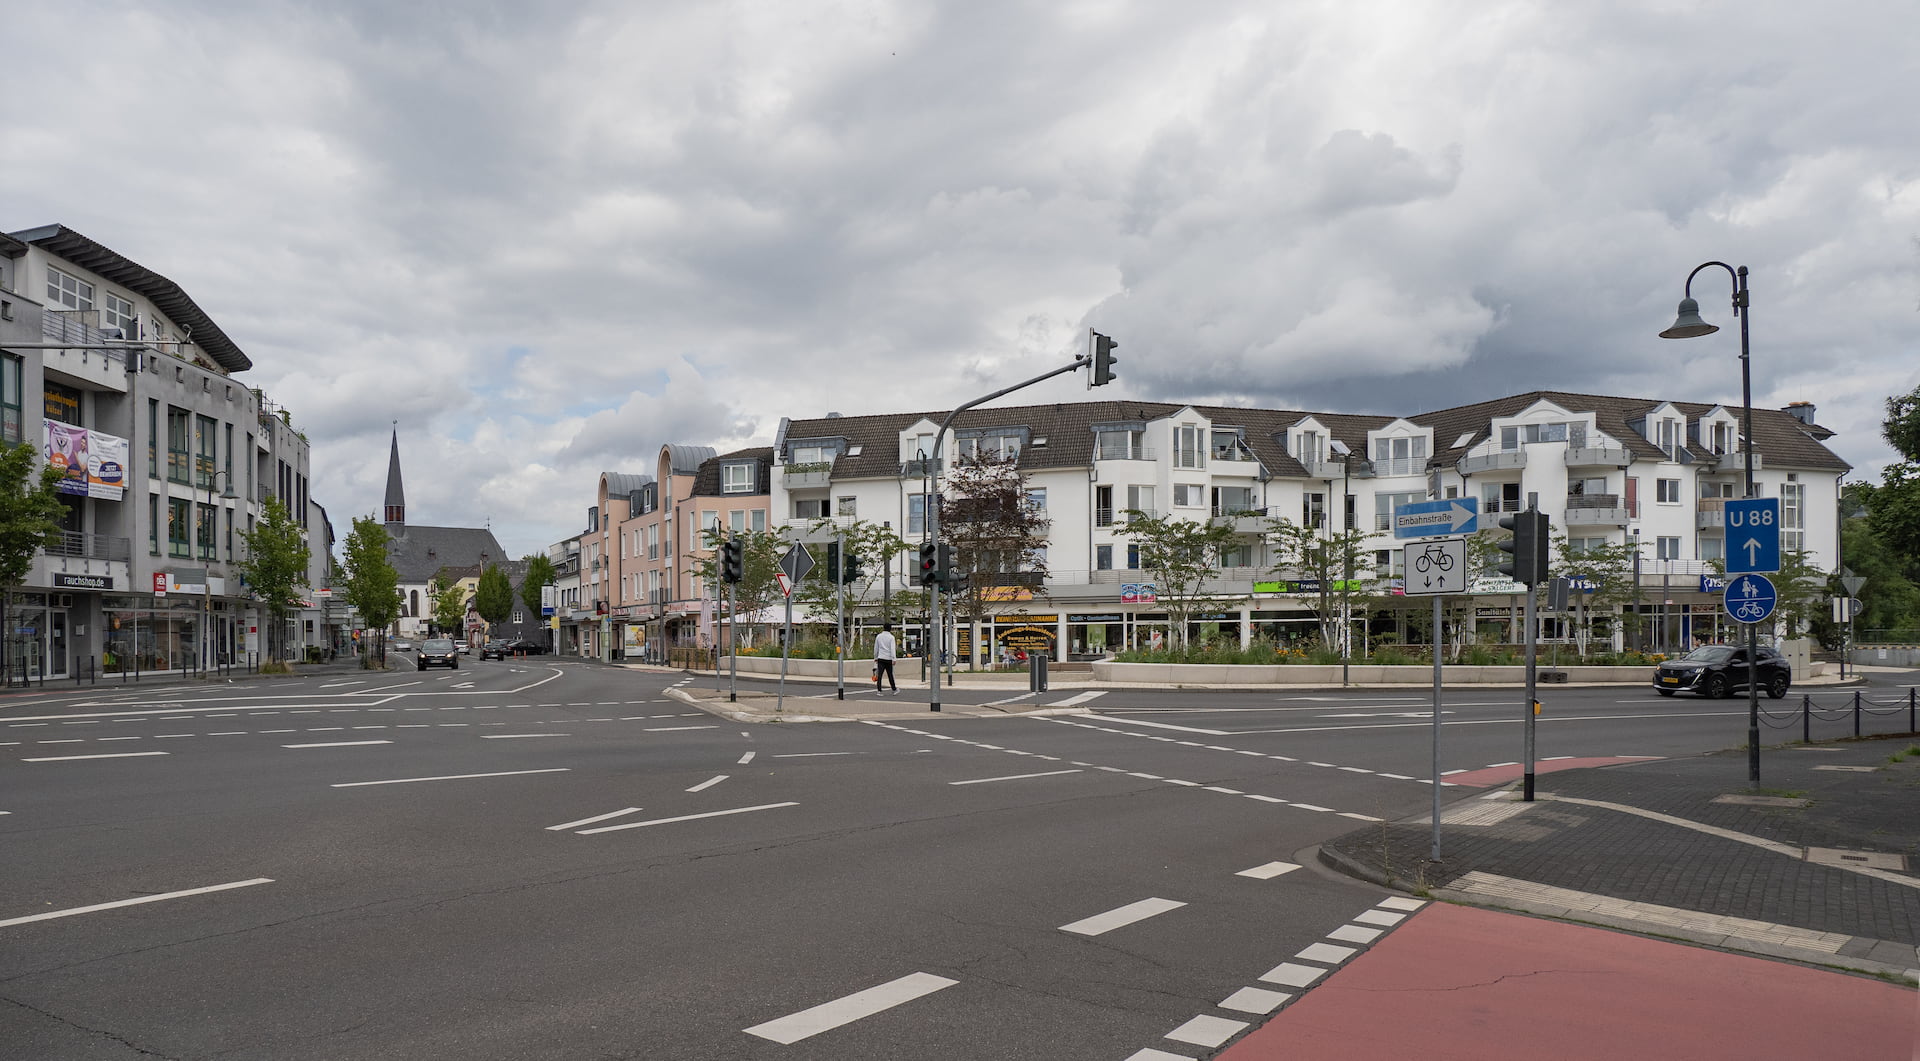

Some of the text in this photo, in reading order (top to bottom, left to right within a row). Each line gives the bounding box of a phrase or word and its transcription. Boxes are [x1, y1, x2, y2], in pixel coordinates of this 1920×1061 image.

[1398, 513, 1452, 526] Einbahnstraße
[1730, 509, 1773, 527] U 88
[64, 575, 105, 588] rauchshop.de
[1477, 608, 1523, 616] Sanitätshs
